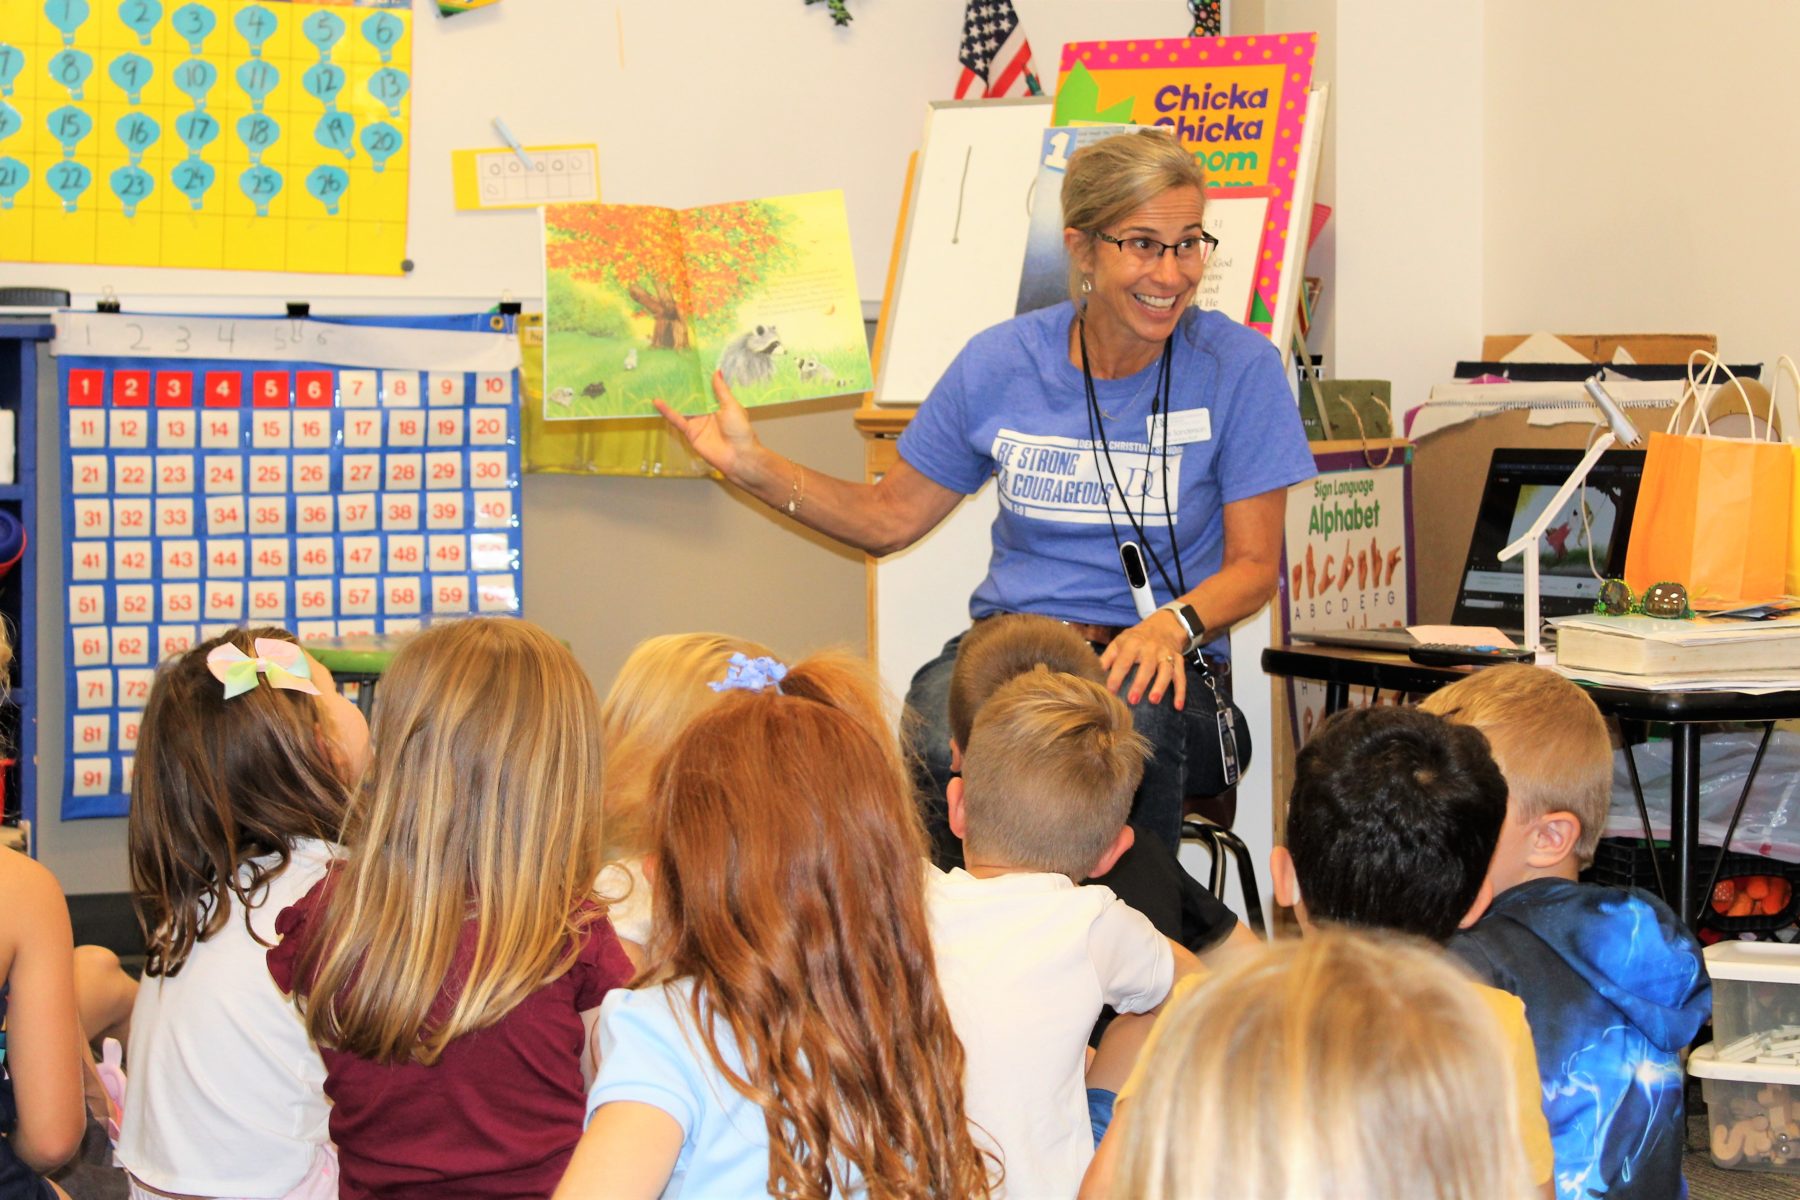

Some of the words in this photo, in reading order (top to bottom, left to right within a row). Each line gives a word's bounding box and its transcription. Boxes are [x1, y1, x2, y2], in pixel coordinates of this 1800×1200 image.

[64, 0, 71, 21] 1
[134, 1, 150, 23] 2
[186, 10, 204, 34] 3
[247, 10, 265, 38] 4
[316, 16, 334, 42] 5
[375, 15, 393, 45] 6
[0, 50, 11, 78] 7
[61, 53, 80, 84] 8
[121, 60, 138, 87] 9
[186, 63, 207, 87] 10
[249, 66, 267, 89] 11
[315, 68, 337, 95] 12
[379, 72, 401, 98] 13
[1154, 82, 1269, 113] Chicka
[60, 113, 81, 138] 15
[128, 119, 149, 144] 16
[188, 117, 210, 140] 17
[249, 119, 269, 145] 18
[327, 117, 346, 144] 19
[370, 131, 396, 152] 20
[0, 167, 16, 187] 21
[59, 167, 84, 190] 22
[121, 174, 145, 196] 23
[184, 167, 205, 191] 24
[252, 174, 275, 195] 25
[317, 173, 341, 196] 26
[85, 324, 91, 345] 1
[126, 323, 151, 351] 2
[176, 325, 192, 353] 3
[217, 322, 236, 353] 4
[82, 378, 90, 396] 1
[125, 378, 139, 397] 2
[168, 379, 182, 397] 3
[216, 379, 231, 398] 4
[264, 379, 279, 398] 5
[307, 380, 321, 399] 6
[352, 380, 364, 397] 7
[394, 379, 407, 397] 8
[440, 379, 454, 397] 9
[485, 377, 505, 394] 10
[81, 421, 95, 434] 11
[120, 420, 138, 437] 12
[168, 420, 186, 437] 13
[210, 421, 229, 438] 14
[262, 420, 281, 437] 15
[302, 420, 321, 437] 16
[354, 419, 373, 436] 17
[399, 419, 417, 436] 18
[437, 419, 457, 436] 19
[475, 418, 500, 436] 20
[81, 466, 100, 484] 21
[122, 466, 146, 484] 22
[163, 465, 187, 484] 23
[211, 466, 236, 484] 24
[257, 465, 282, 484] 25
[300, 464, 324, 482] 26
[350, 463, 374, 482] 27
[392, 463, 416, 481] 28
[432, 462, 457, 480] 29
[477, 462, 502, 480] 30
[998, 442, 1017, 466] BE
[1017, 447, 1081, 476] STRONG
[1012, 473, 1114, 506] COURAGEOUS
[1314, 480, 1332, 501] Sign
[1334, 478, 1374, 498] Language
[83, 510, 103, 528] 31
[121, 509, 144, 528] 32
[164, 508, 188, 527] 33
[215, 506, 240, 524] 34
[256, 508, 281, 525] 35
[303, 506, 328, 524] 36
[346, 503, 369, 522] 37
[390, 504, 414, 521] 38
[432, 503, 458, 520] 39
[480, 501, 506, 519] 40
[1308, 499, 1381, 542] Alphabet
[82, 552, 101, 569] 41
[121, 552, 146, 570] 42
[169, 551, 194, 569] 43
[212, 550, 239, 567] 44
[258, 549, 283, 568] 45
[303, 548, 328, 566] 46
[349, 547, 373, 564] 47
[393, 545, 419, 563] 48
[435, 544, 461, 562] 49
[78, 596, 97, 614] 51
[123, 595, 148, 614] 52
[168, 594, 193, 613] 53
[211, 592, 236, 609] 54
[255, 592, 280, 609] 55
[301, 591, 326, 609] 56
[348, 587, 372, 606] 57
[391, 587, 416, 606] 58
[439, 586, 464, 605] 59
[1295, 607, 1301, 621] A
[1310, 603, 1316, 618] B
[1325, 600, 1332, 615] C
[1341, 598, 1348, 613] D
[1359, 594, 1366, 610] E
[1373, 592, 1380, 607] F
[1387, 590, 1396, 606] G
[81, 638, 101, 657] 61
[117, 637, 143, 656] 62
[163, 637, 190, 655] 63
[87, 680, 105, 698] 71
[126, 680, 149, 698] 72
[82, 726, 103, 744] 81
[125, 723, 139, 741] 8
[83, 770, 103, 788] 91
